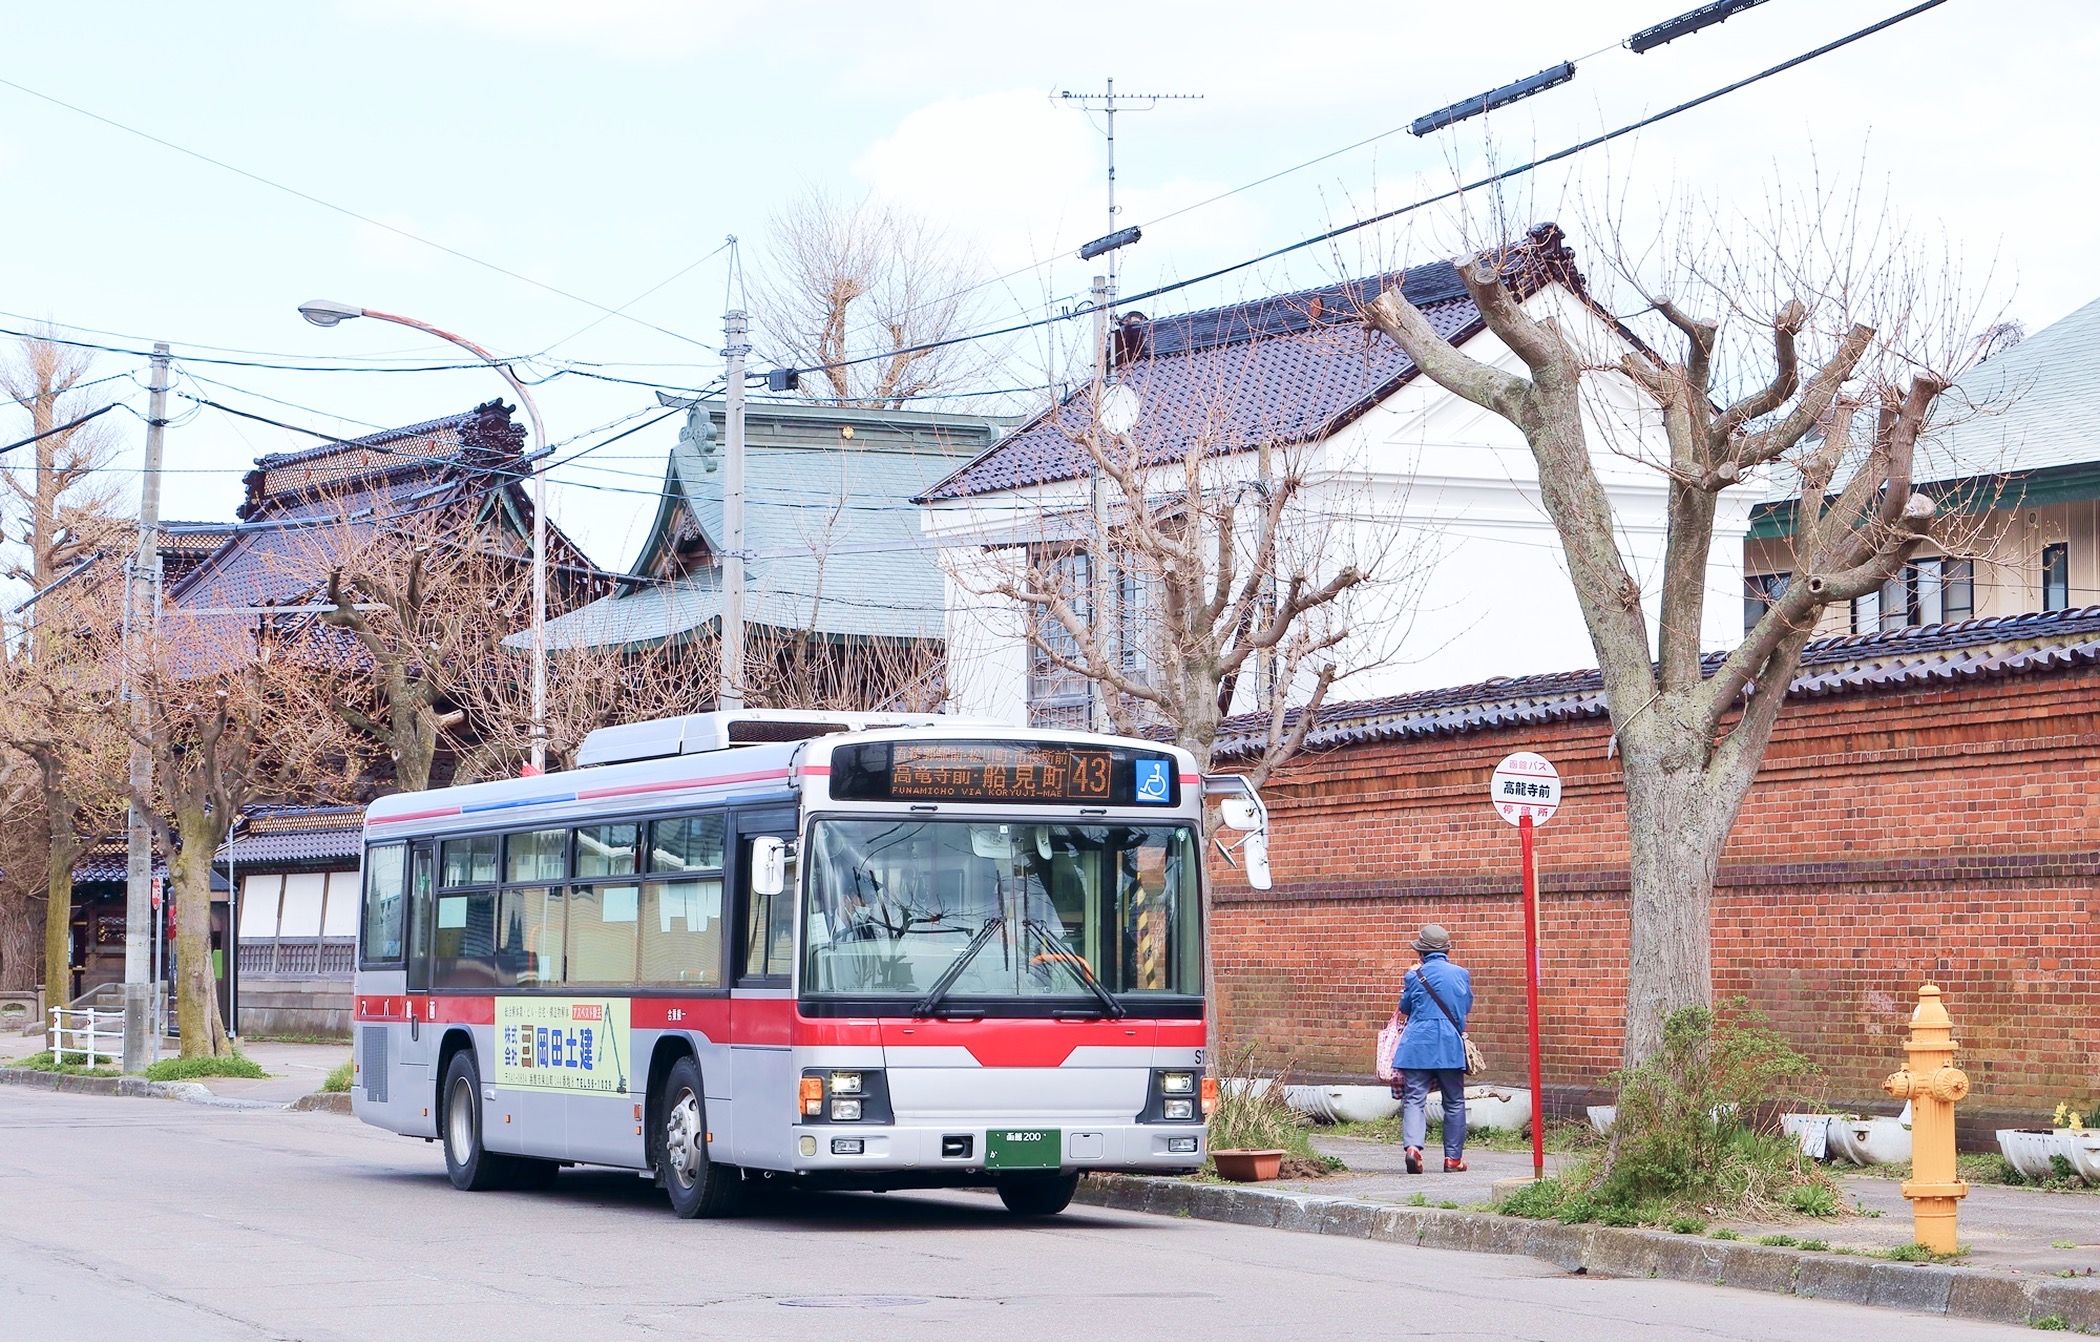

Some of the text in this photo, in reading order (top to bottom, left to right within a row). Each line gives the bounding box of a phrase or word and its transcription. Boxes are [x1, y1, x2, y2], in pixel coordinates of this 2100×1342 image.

[1072, 756, 1107, 793] 43
[1509, 759, 1547, 772] 函館バス
[961, 788, 982, 796] VIA
[988, 788, 1063, 798] KORYUJI-MAE
[1503, 780, 1550, 799] 高龍寺前
[536, 1027, 593, 1071] 岡田土建
